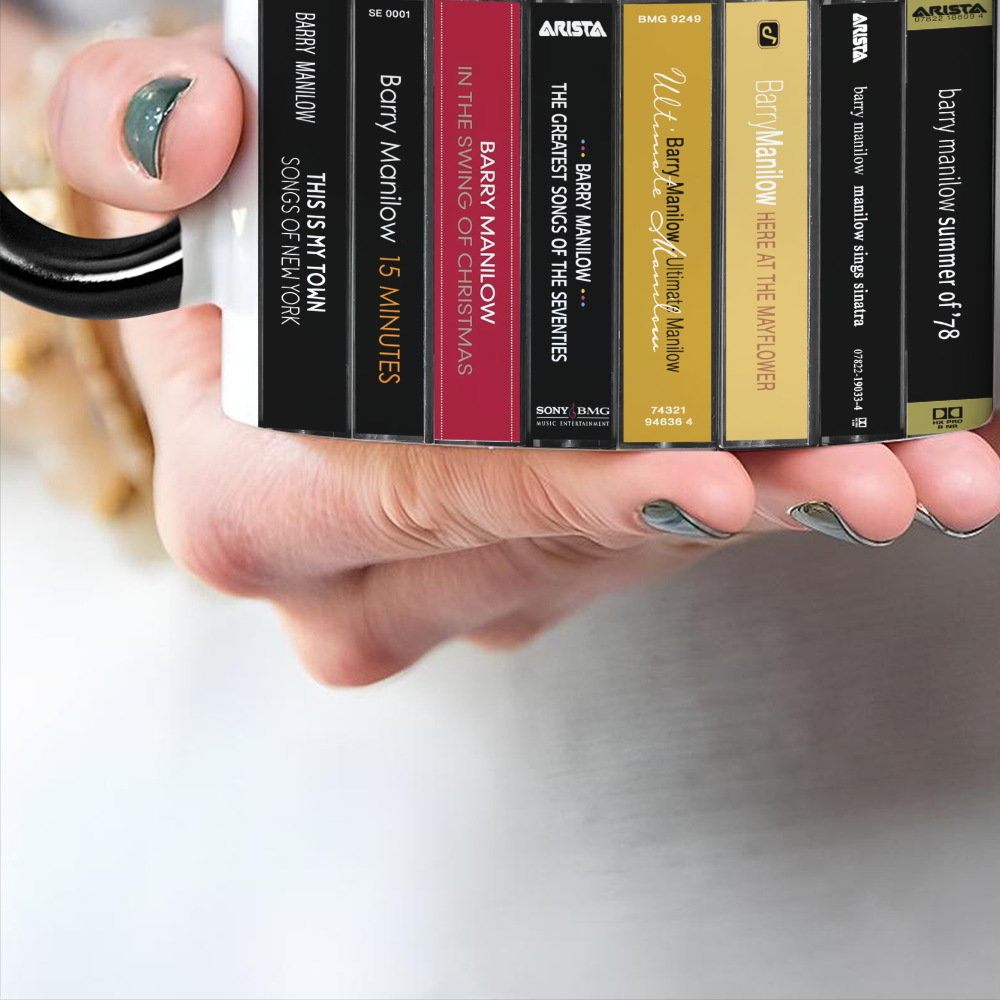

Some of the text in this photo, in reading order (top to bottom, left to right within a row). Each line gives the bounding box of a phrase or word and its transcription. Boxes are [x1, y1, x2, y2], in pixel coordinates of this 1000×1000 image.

[539, 20, 607, 37] ARISTA
[638, 15, 701, 23] BMG 9249
[933, 89, 961, 132] barry
[850, 86, 868, 327] barry manilow manilow sings sinatra
[939, 139, 961, 211] manilow
[281, 157, 300, 325] SONGS OF NEW YORK
[307, 173, 326, 312] THIS IS MY TOWN
[375, 75, 402, 383] Barry Manilow 15 MINUTES
[458, 67, 472, 375] IN THE SWING OF CHRISTMAS
[551, 83, 567, 362] THE GREATEST SONGS OF THE SEVENTIES
[937, 217, 960, 287] summer
[757, 212, 776, 390] HERE AT THE MAYFLOWER
[939, 292, 962, 308] of
[645, 418, 682, 426] 94636
[651, 406, 685, 414] 74321
